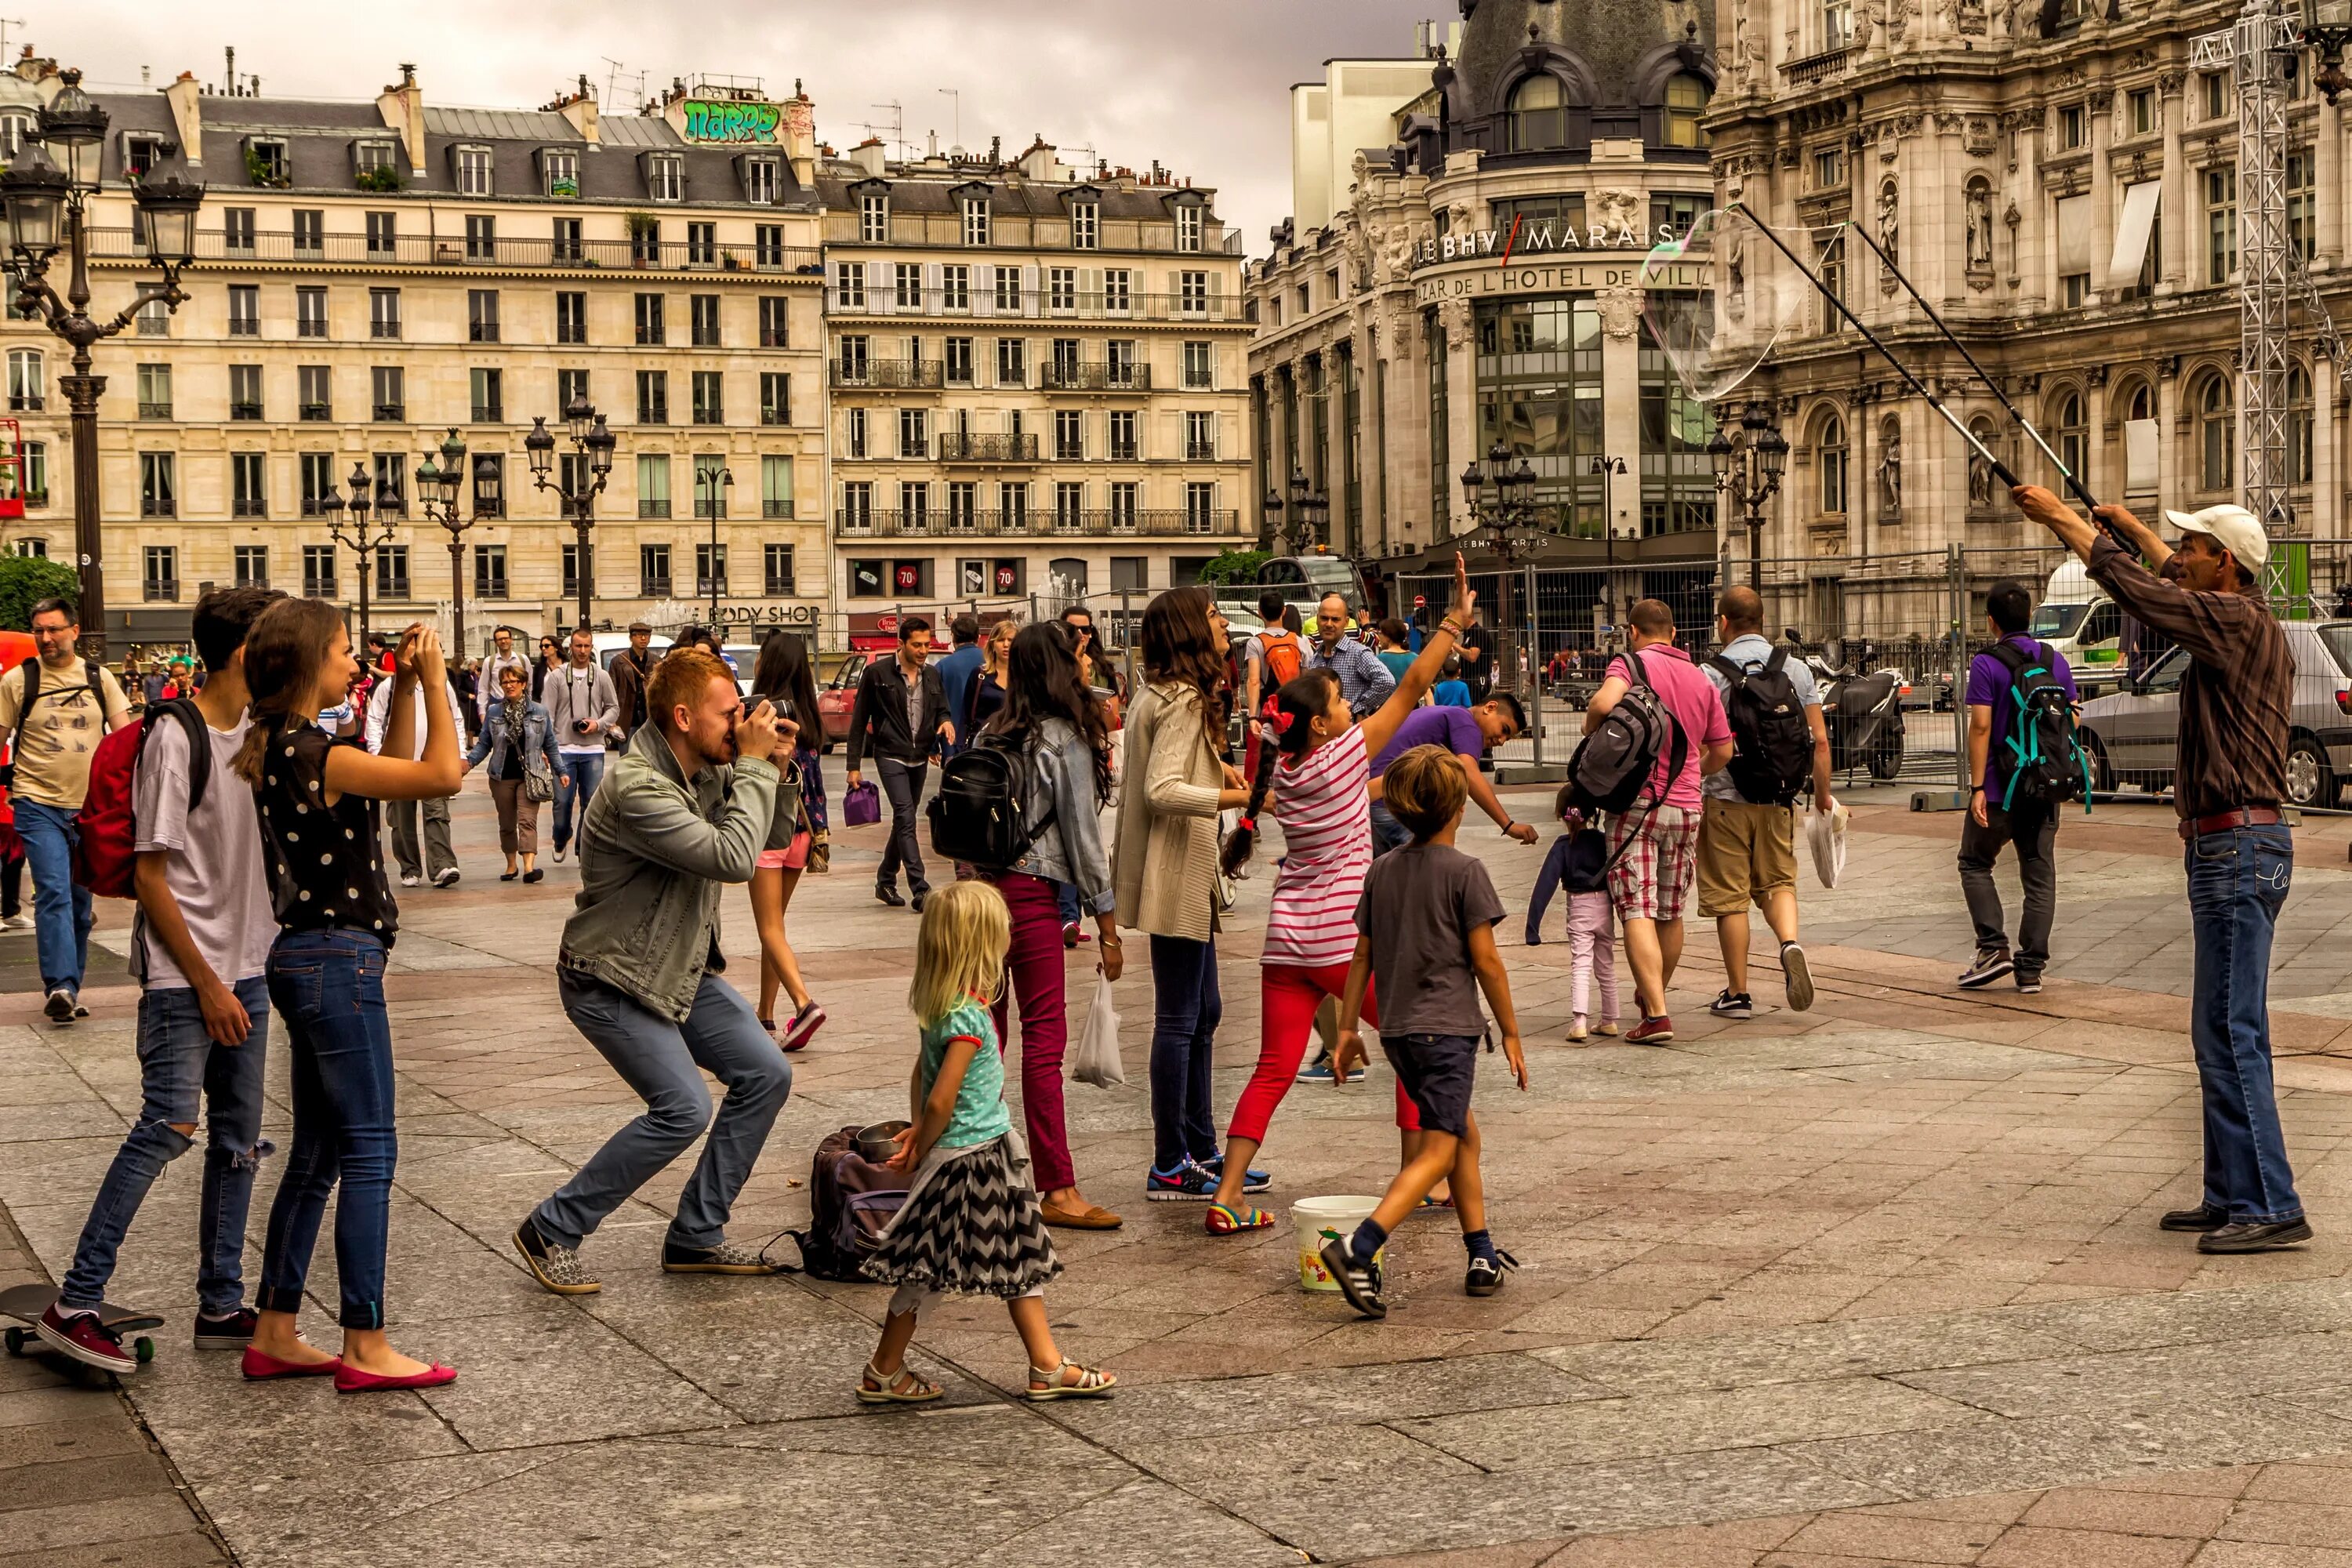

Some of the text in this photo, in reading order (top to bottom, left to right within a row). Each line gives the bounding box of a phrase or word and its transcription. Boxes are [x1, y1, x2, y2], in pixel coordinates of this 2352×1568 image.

[1417, 239, 1435, 263] LE
[1443, 230, 1497, 258] BHV
[1526, 223, 1674, 250] MARAIS
[1415, 267, 1710, 303] AZAR DE L'HOTEL DE VILL
